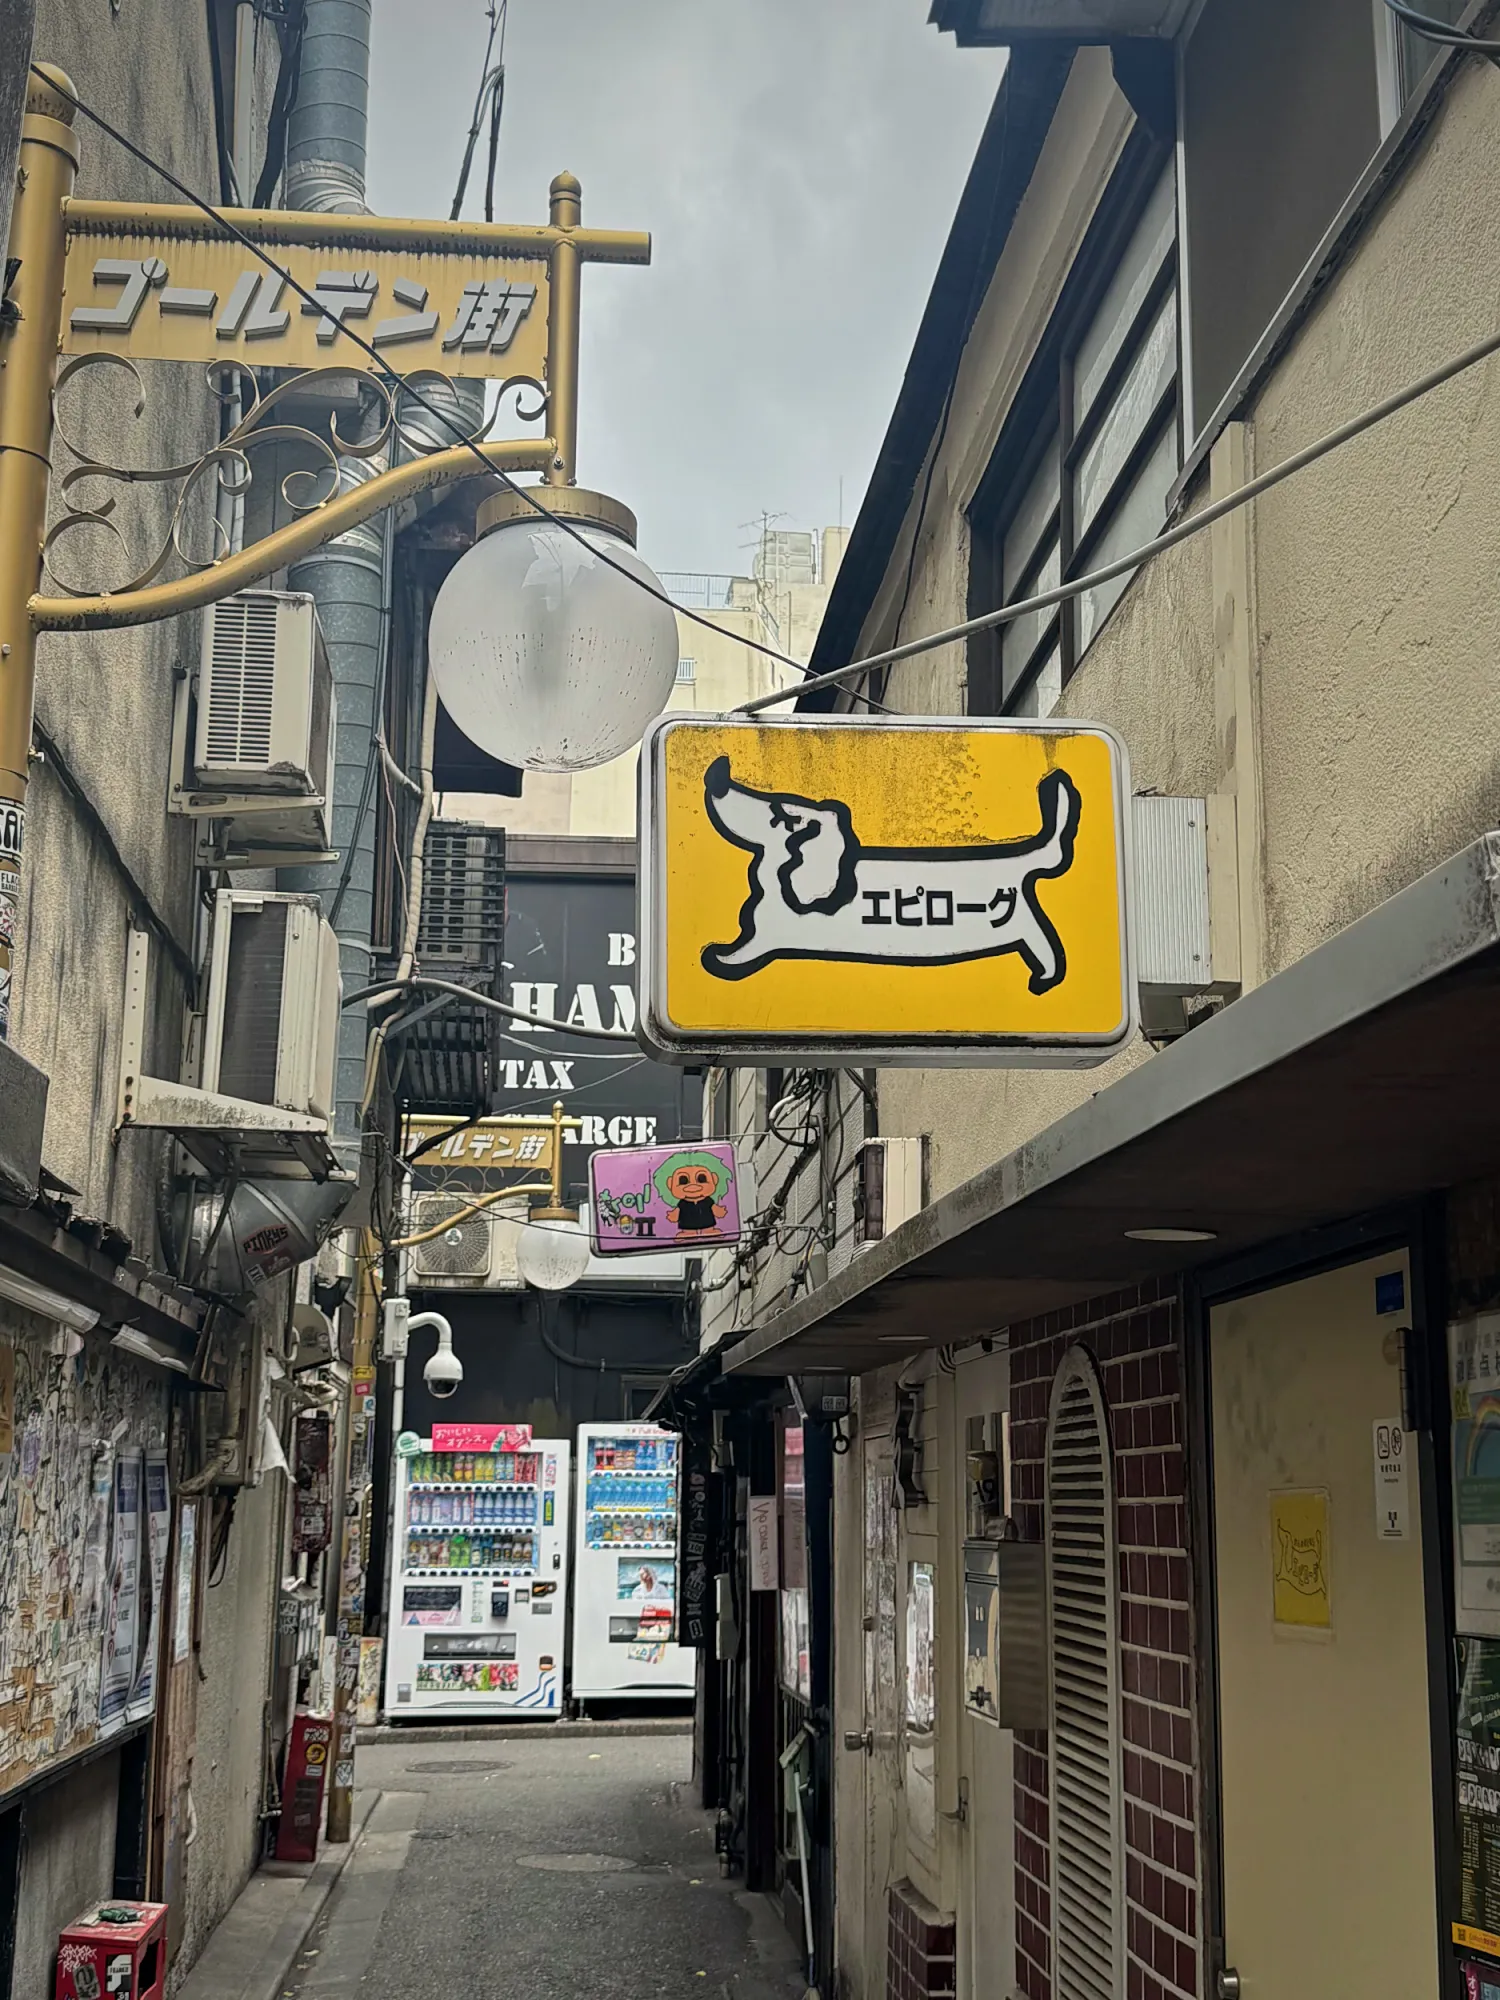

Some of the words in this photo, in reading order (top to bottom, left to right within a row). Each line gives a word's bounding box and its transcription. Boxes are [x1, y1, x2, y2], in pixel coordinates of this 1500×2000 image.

[70, 256, 537, 352] ゴールデン街
[861, 885, 1018, 928] エピローグ
[499, 1060, 575, 1090] TAX
